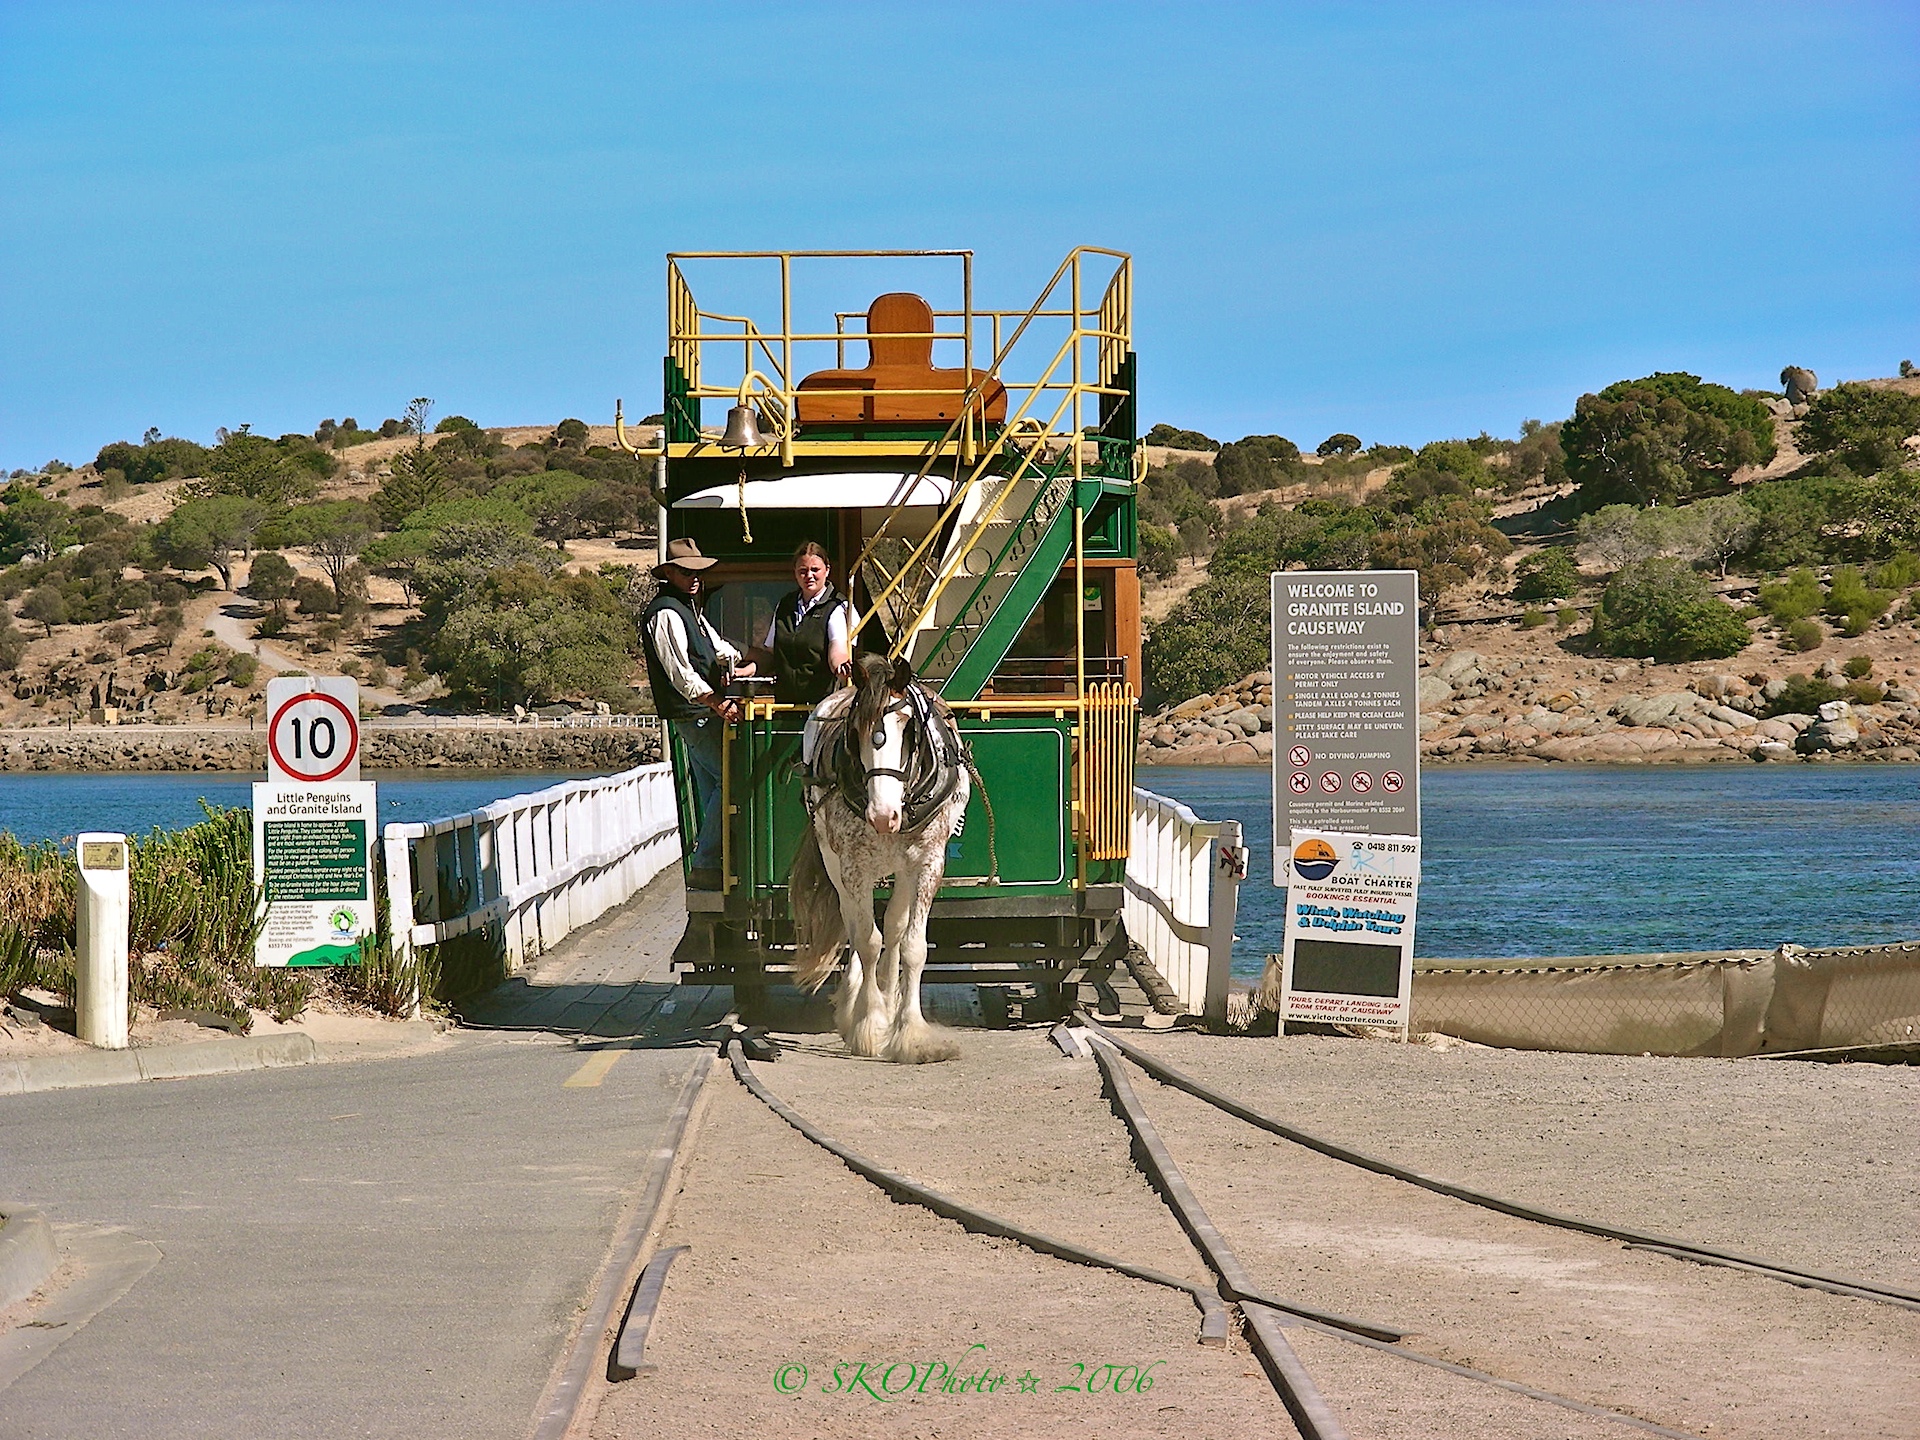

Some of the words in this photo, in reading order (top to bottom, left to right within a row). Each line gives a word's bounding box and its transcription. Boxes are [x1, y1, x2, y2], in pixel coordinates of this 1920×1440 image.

[1288, 584, 1354, 598] WELCOME
[1360, 584, 1378, 597] TO
[1288, 603, 1349, 616] GRANITE
[1353, 602, 1405, 616] ISLAND
[1288, 621, 1366, 635] CAUSEWAY
[1301, 643, 1329, 651] following
[1323, 651, 1354, 659] enjoyment
[292, 717, 335, 759] 10
[277, 793, 304, 803] Little
[307, 792, 351, 804] Penguins
[267, 804, 286, 814] and
[289, 804, 329, 814] Granite
[331, 804, 362, 814] Island
[1368, 843, 1385, 851] 0418
[1388, 843, 1399, 852] 811
[1401, 844, 1416, 853] 592
[1332, 877, 1359, 886] BOAT
[1364, 878, 1412, 889] CHARTER
[1306, 893, 1350, 901] BOOKINGS
[1353, 895, 1397, 904] ESSENTIAL
[1297, 904, 1340, 918] Whale
[1342, 907, 1406, 924] Watching
[1298, 917, 1310, 928] &
[1312, 917, 1363, 932] Dolphin
[1365, 920, 1402, 934] Tours
[1315, 998, 1344, 1006] DEPART
[1346, 1000, 1380, 1008] LANDING
[1352, 1007, 1394, 1015] CAUSEWAY
[1288, 1013, 1397, 1025] www.victorcharter.com.au
